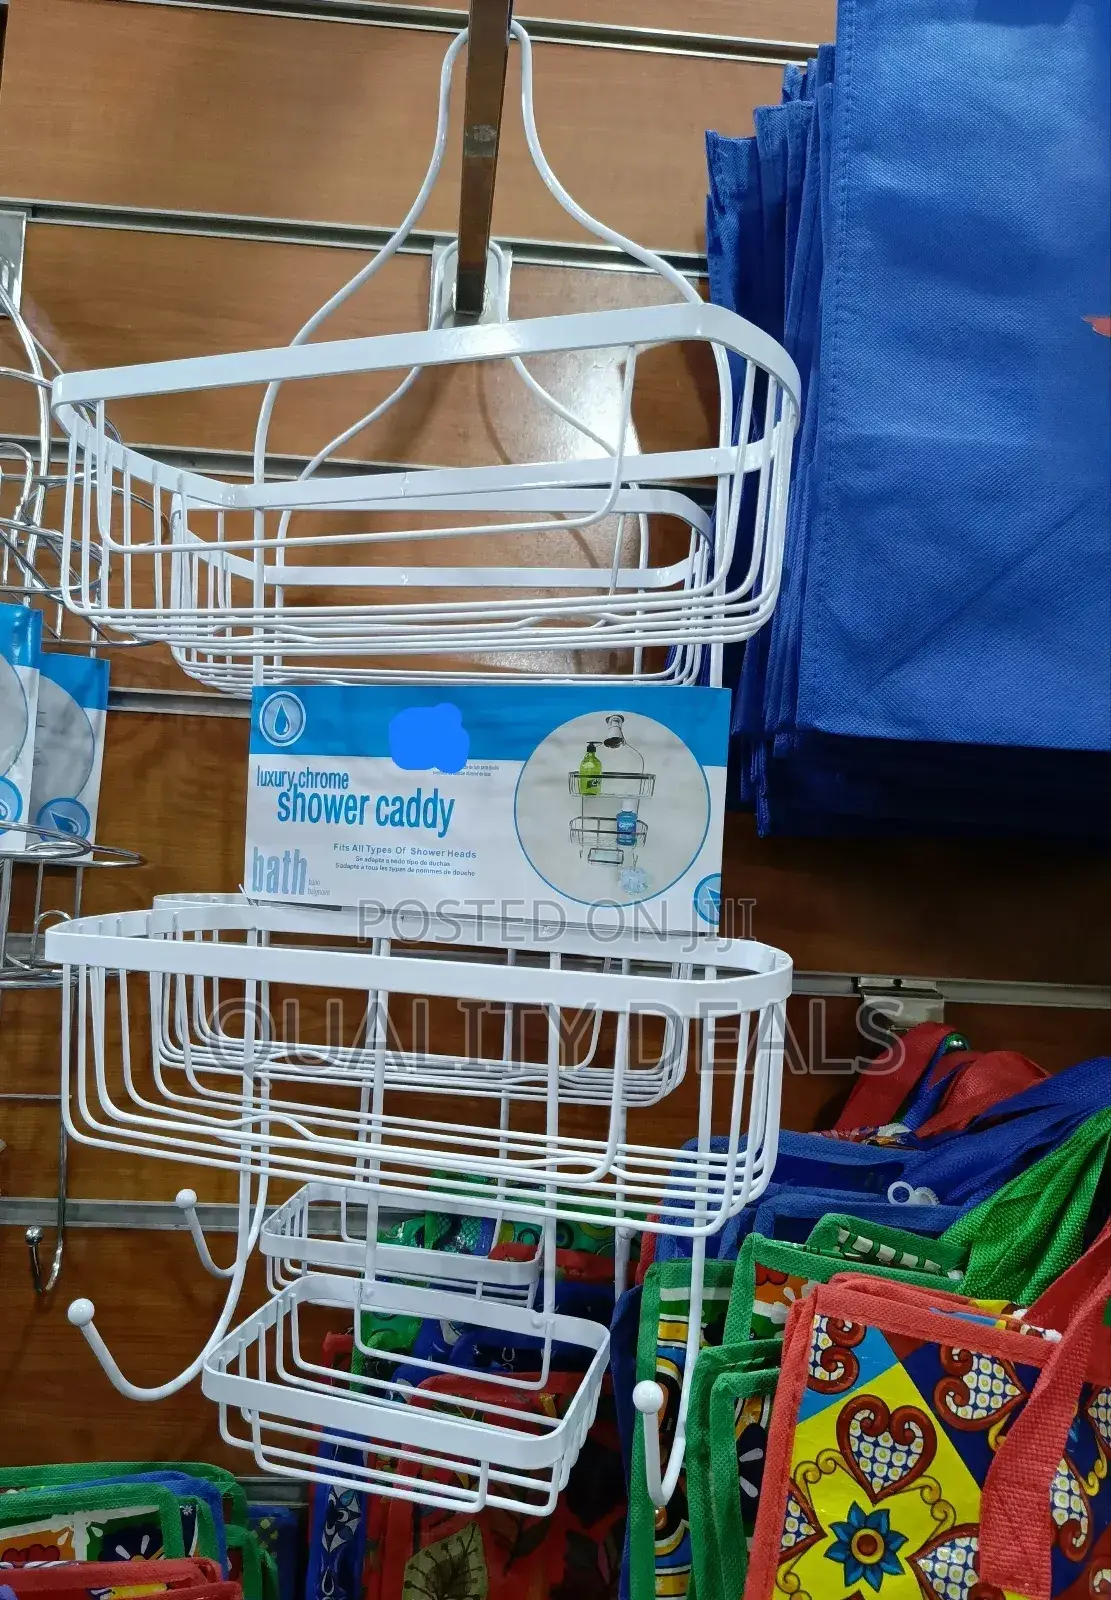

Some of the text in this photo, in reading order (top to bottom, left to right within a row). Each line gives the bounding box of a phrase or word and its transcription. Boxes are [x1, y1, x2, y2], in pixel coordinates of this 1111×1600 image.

[256, 766, 349, 792] luxury chrome
[277, 784, 455, 838] shower caddy
[333, 843, 477, 859] Fits All Types Of Shower Heads
[252, 846, 307, 895] bath
